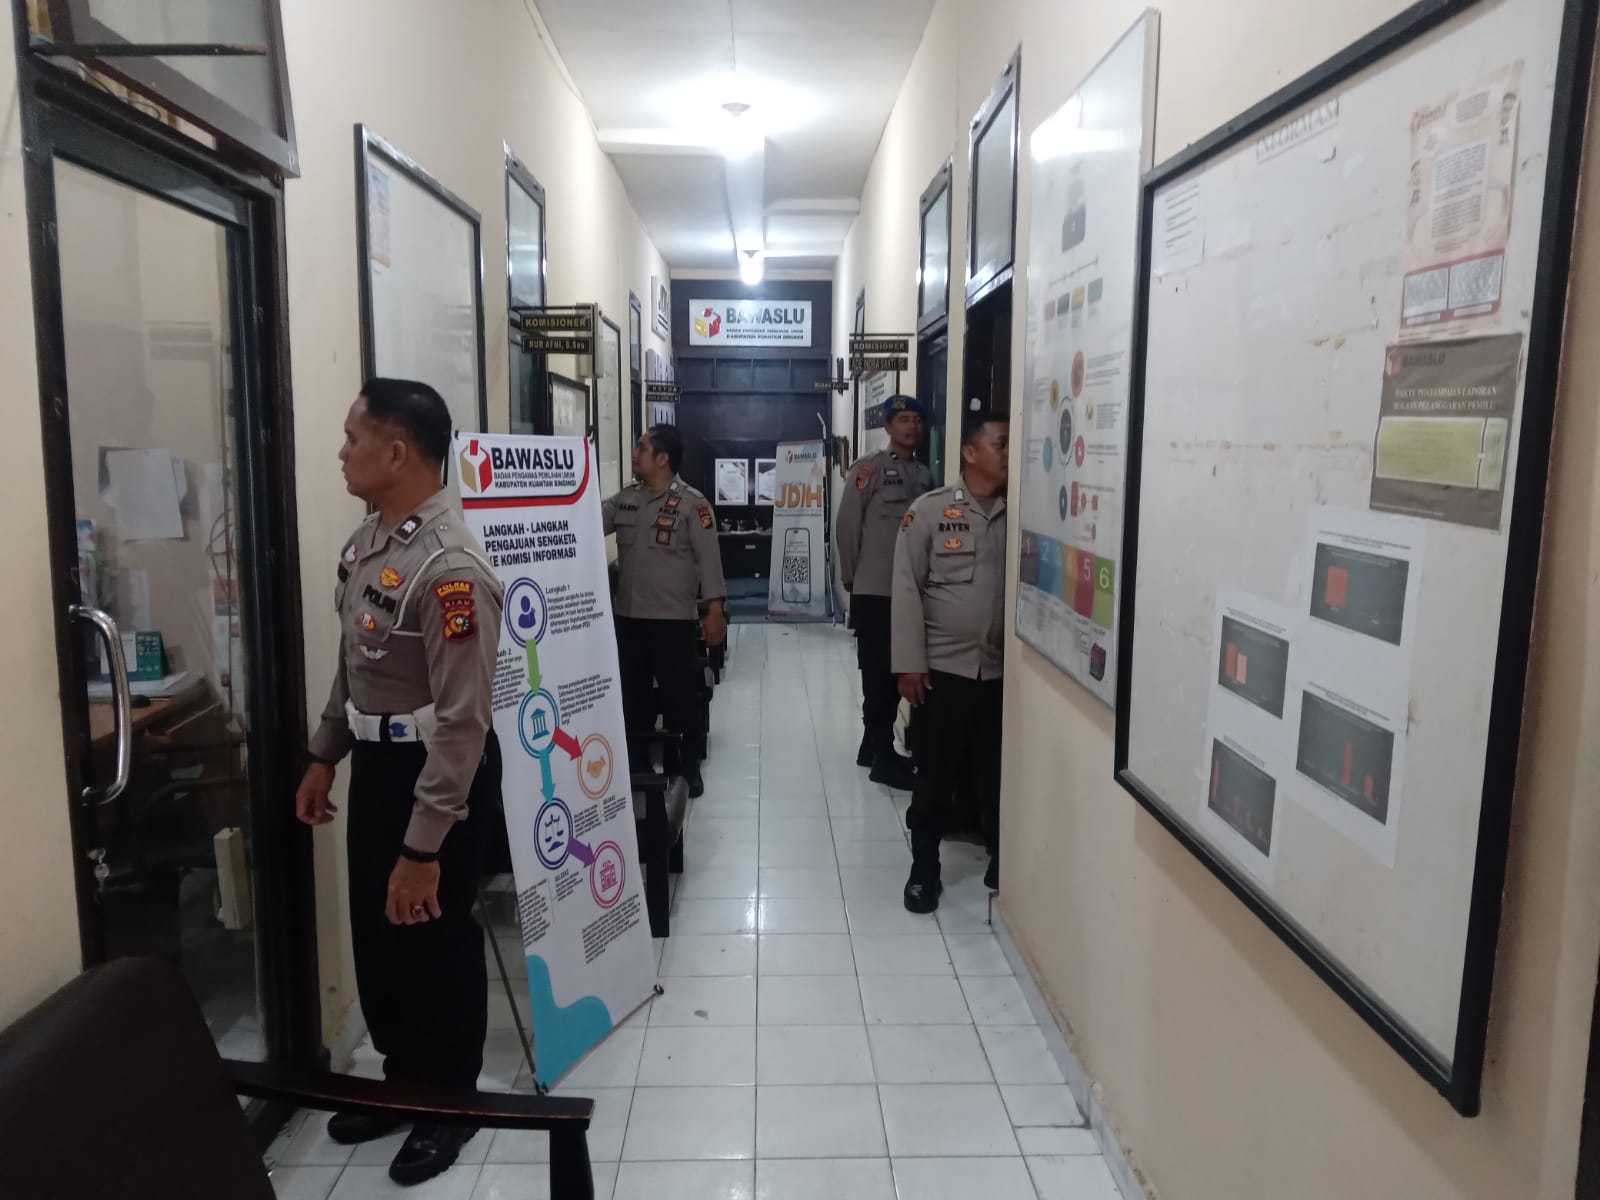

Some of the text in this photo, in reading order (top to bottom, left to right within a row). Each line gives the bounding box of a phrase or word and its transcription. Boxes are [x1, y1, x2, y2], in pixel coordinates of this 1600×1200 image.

[525, 318, 587, 328] KOMISIONER
[726, 308, 805, 324] BAWASLU
[853, 342, 905, 351] KOMISIONER
[491, 447, 574, 470] BAWASLU
[774, 484, 822, 508] JDIH
[483, 523, 525, 537] LANGKAH
[530, 520, 569, 534] LANGKAH
[938, 522, 970, 532] RAYEN
[485, 533, 577, 552] PENGAJUAN SENGKETA
[1041, 541, 1049, 562] 2
[501, 552, 531, 567] KOMISI
[533, 547, 576, 563] INFORMASI
[1084, 560, 1091, 580] 5
[1100, 567, 1110, 589] 6
[363, 584, 397, 614] POLRI
[444, 599, 470, 608] RIAU
